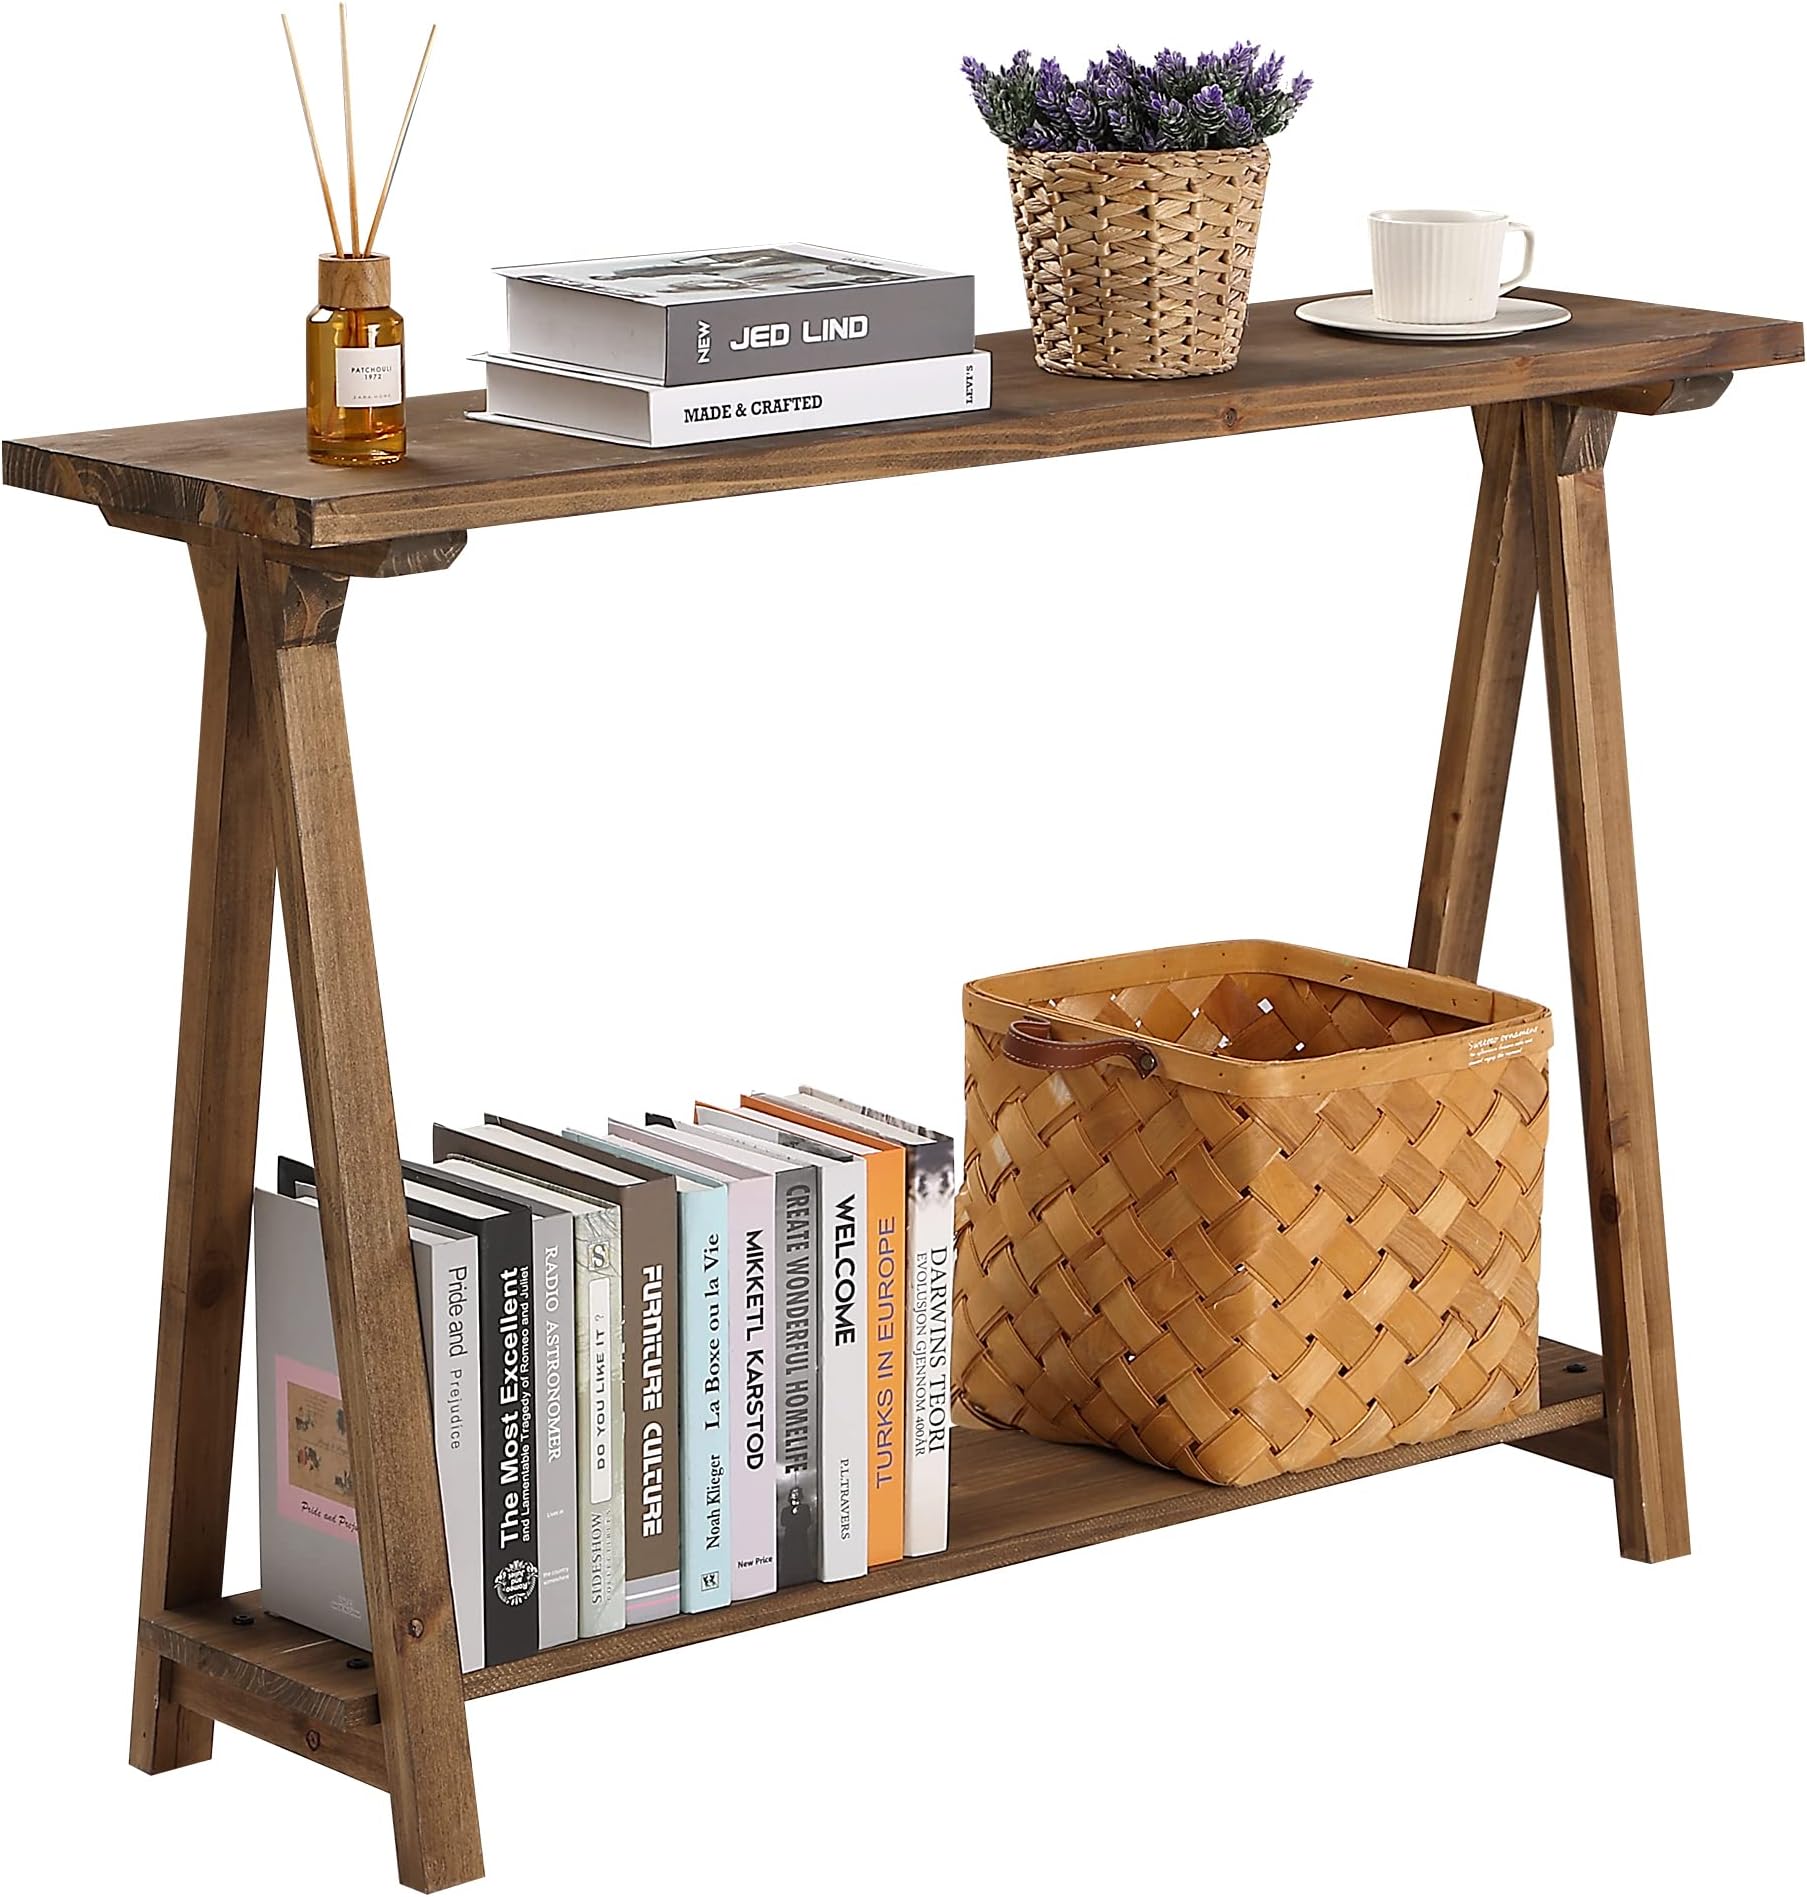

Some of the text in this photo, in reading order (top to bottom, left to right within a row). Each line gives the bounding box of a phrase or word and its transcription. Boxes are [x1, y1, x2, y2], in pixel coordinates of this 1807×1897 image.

[697, 320, 711, 364] NEW
[730, 315, 869, 351] JED LIND
[684, 394, 823, 423] MADE & CRAFTED
[448, 1266, 468, 1357] Pride and
[835, 1193, 856, 1347] WELCOME
[913, 1253, 927, 1336] EVOLUSJON
[545, 1246, 561, 1463] RADIO ASTRONOMER
[704, 1233, 720, 1430] La Boxe ou la Vie
[746, 1229, 764, 1470] MIKKETL KARSTOD
[785, 1184, 810, 1474] CREATE WONDERFUL HOMELIFE
[877, 1216, 895, 1489] TURKS IN EUROPE
[913, 1341, 927, 1411] GJENNOM
[929, 1247, 947, 1453] DARWINS TEORI
[448, 1369, 462, 1449] Prejudice
[500, 1267, 519, 1549] The Most Excellent
[520, 1266, 531, 1541] and Lamentable Tragedy of Romeo and Juliet
[594, 1314, 606, 1470] DO YOU LIKE IT ?
[642, 1421, 662, 1537] CULTURE
[706, 1455, 724, 1550] Noah Klieger
[592, 1513, 602, 1604] SIDESHOW
[737, 1556, 773, 1569] New Price
